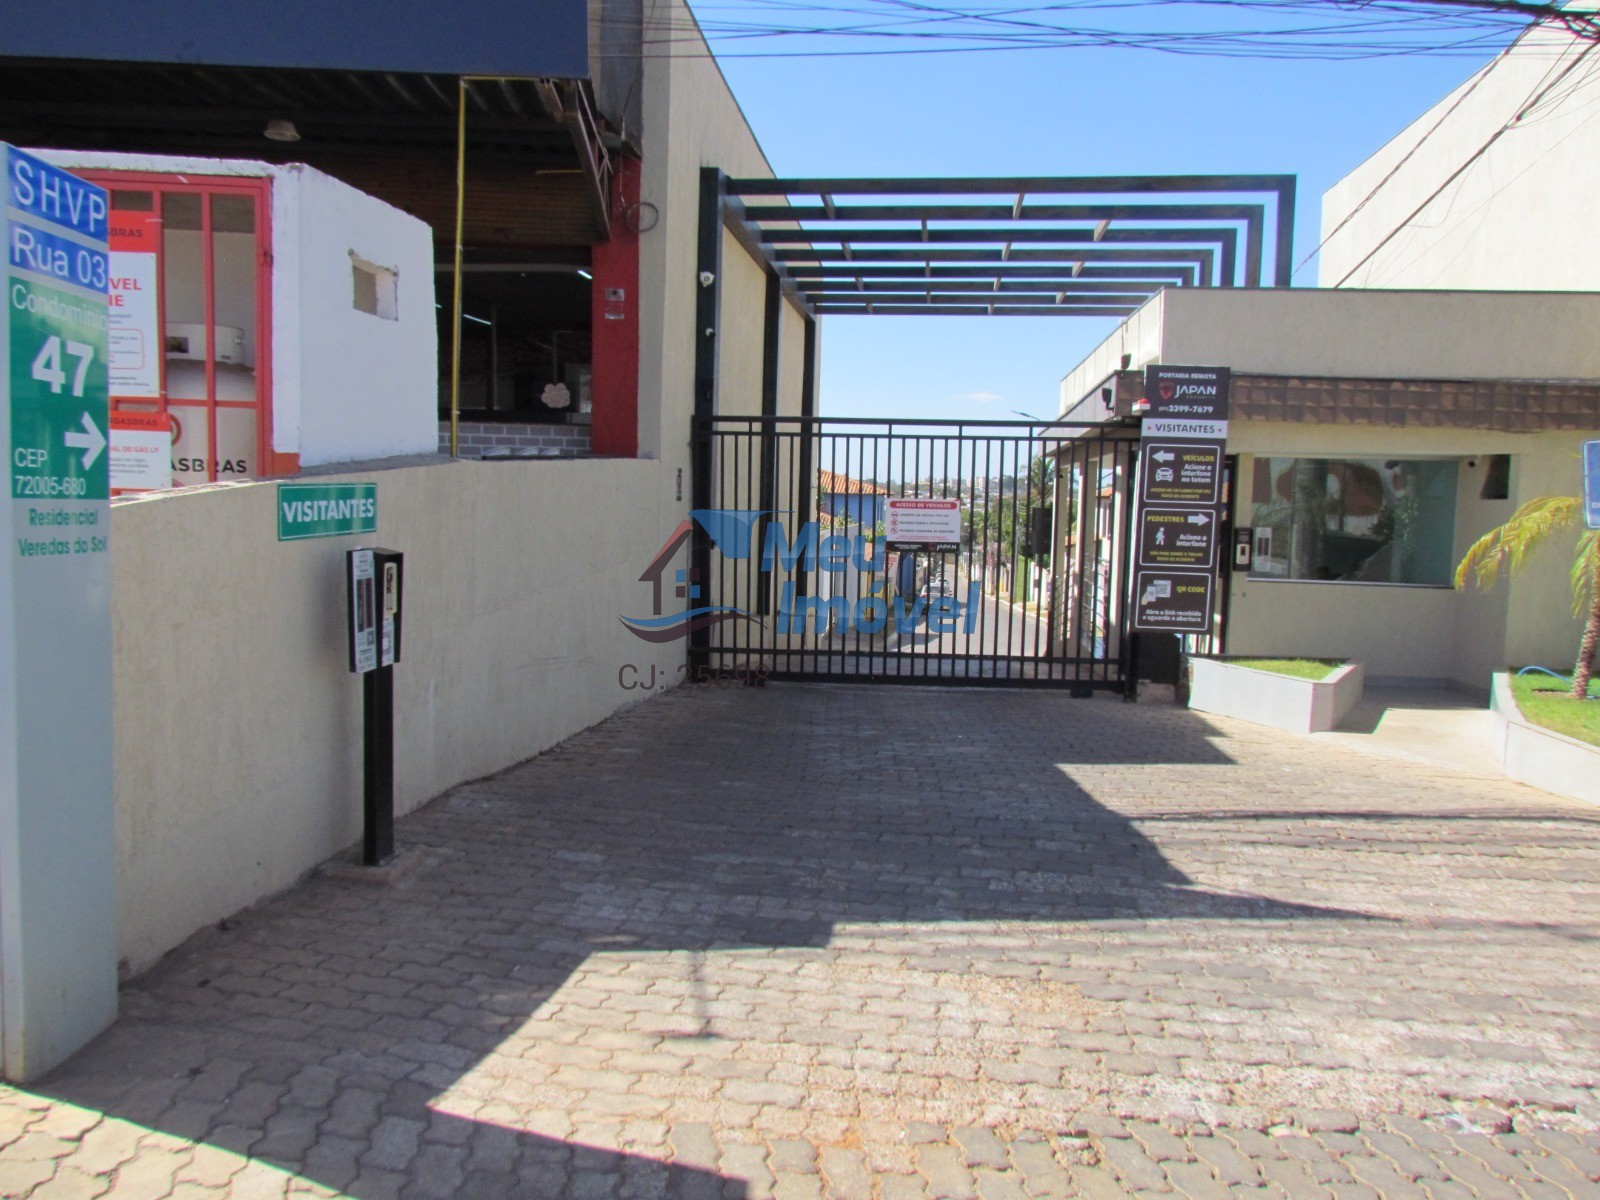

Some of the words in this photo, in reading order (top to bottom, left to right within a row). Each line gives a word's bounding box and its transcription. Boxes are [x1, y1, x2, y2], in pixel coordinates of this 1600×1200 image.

[14, 159, 106, 233] SHVP
[109, 227, 143, 238] BRAS
[14, 227, 70, 278] Rua
[76, 250, 106, 288] 03
[32, 335, 94, 397] 47
[1174, 385, 1217, 398] JAPAN
[1155, 423, 1215, 434] VISITANTES
[14, 447, 48, 468] CEP
[15, 475, 87, 496] 72005-680
[29, 508, 98, 526] Residencial
[282, 499, 375, 523] VISITANTES
[1147, 515, 1185, 523] PEDESTRES
[17, 537, 70, 556] Veredas
[74, 537, 88, 553] do
[91, 536, 107, 552] Sol
